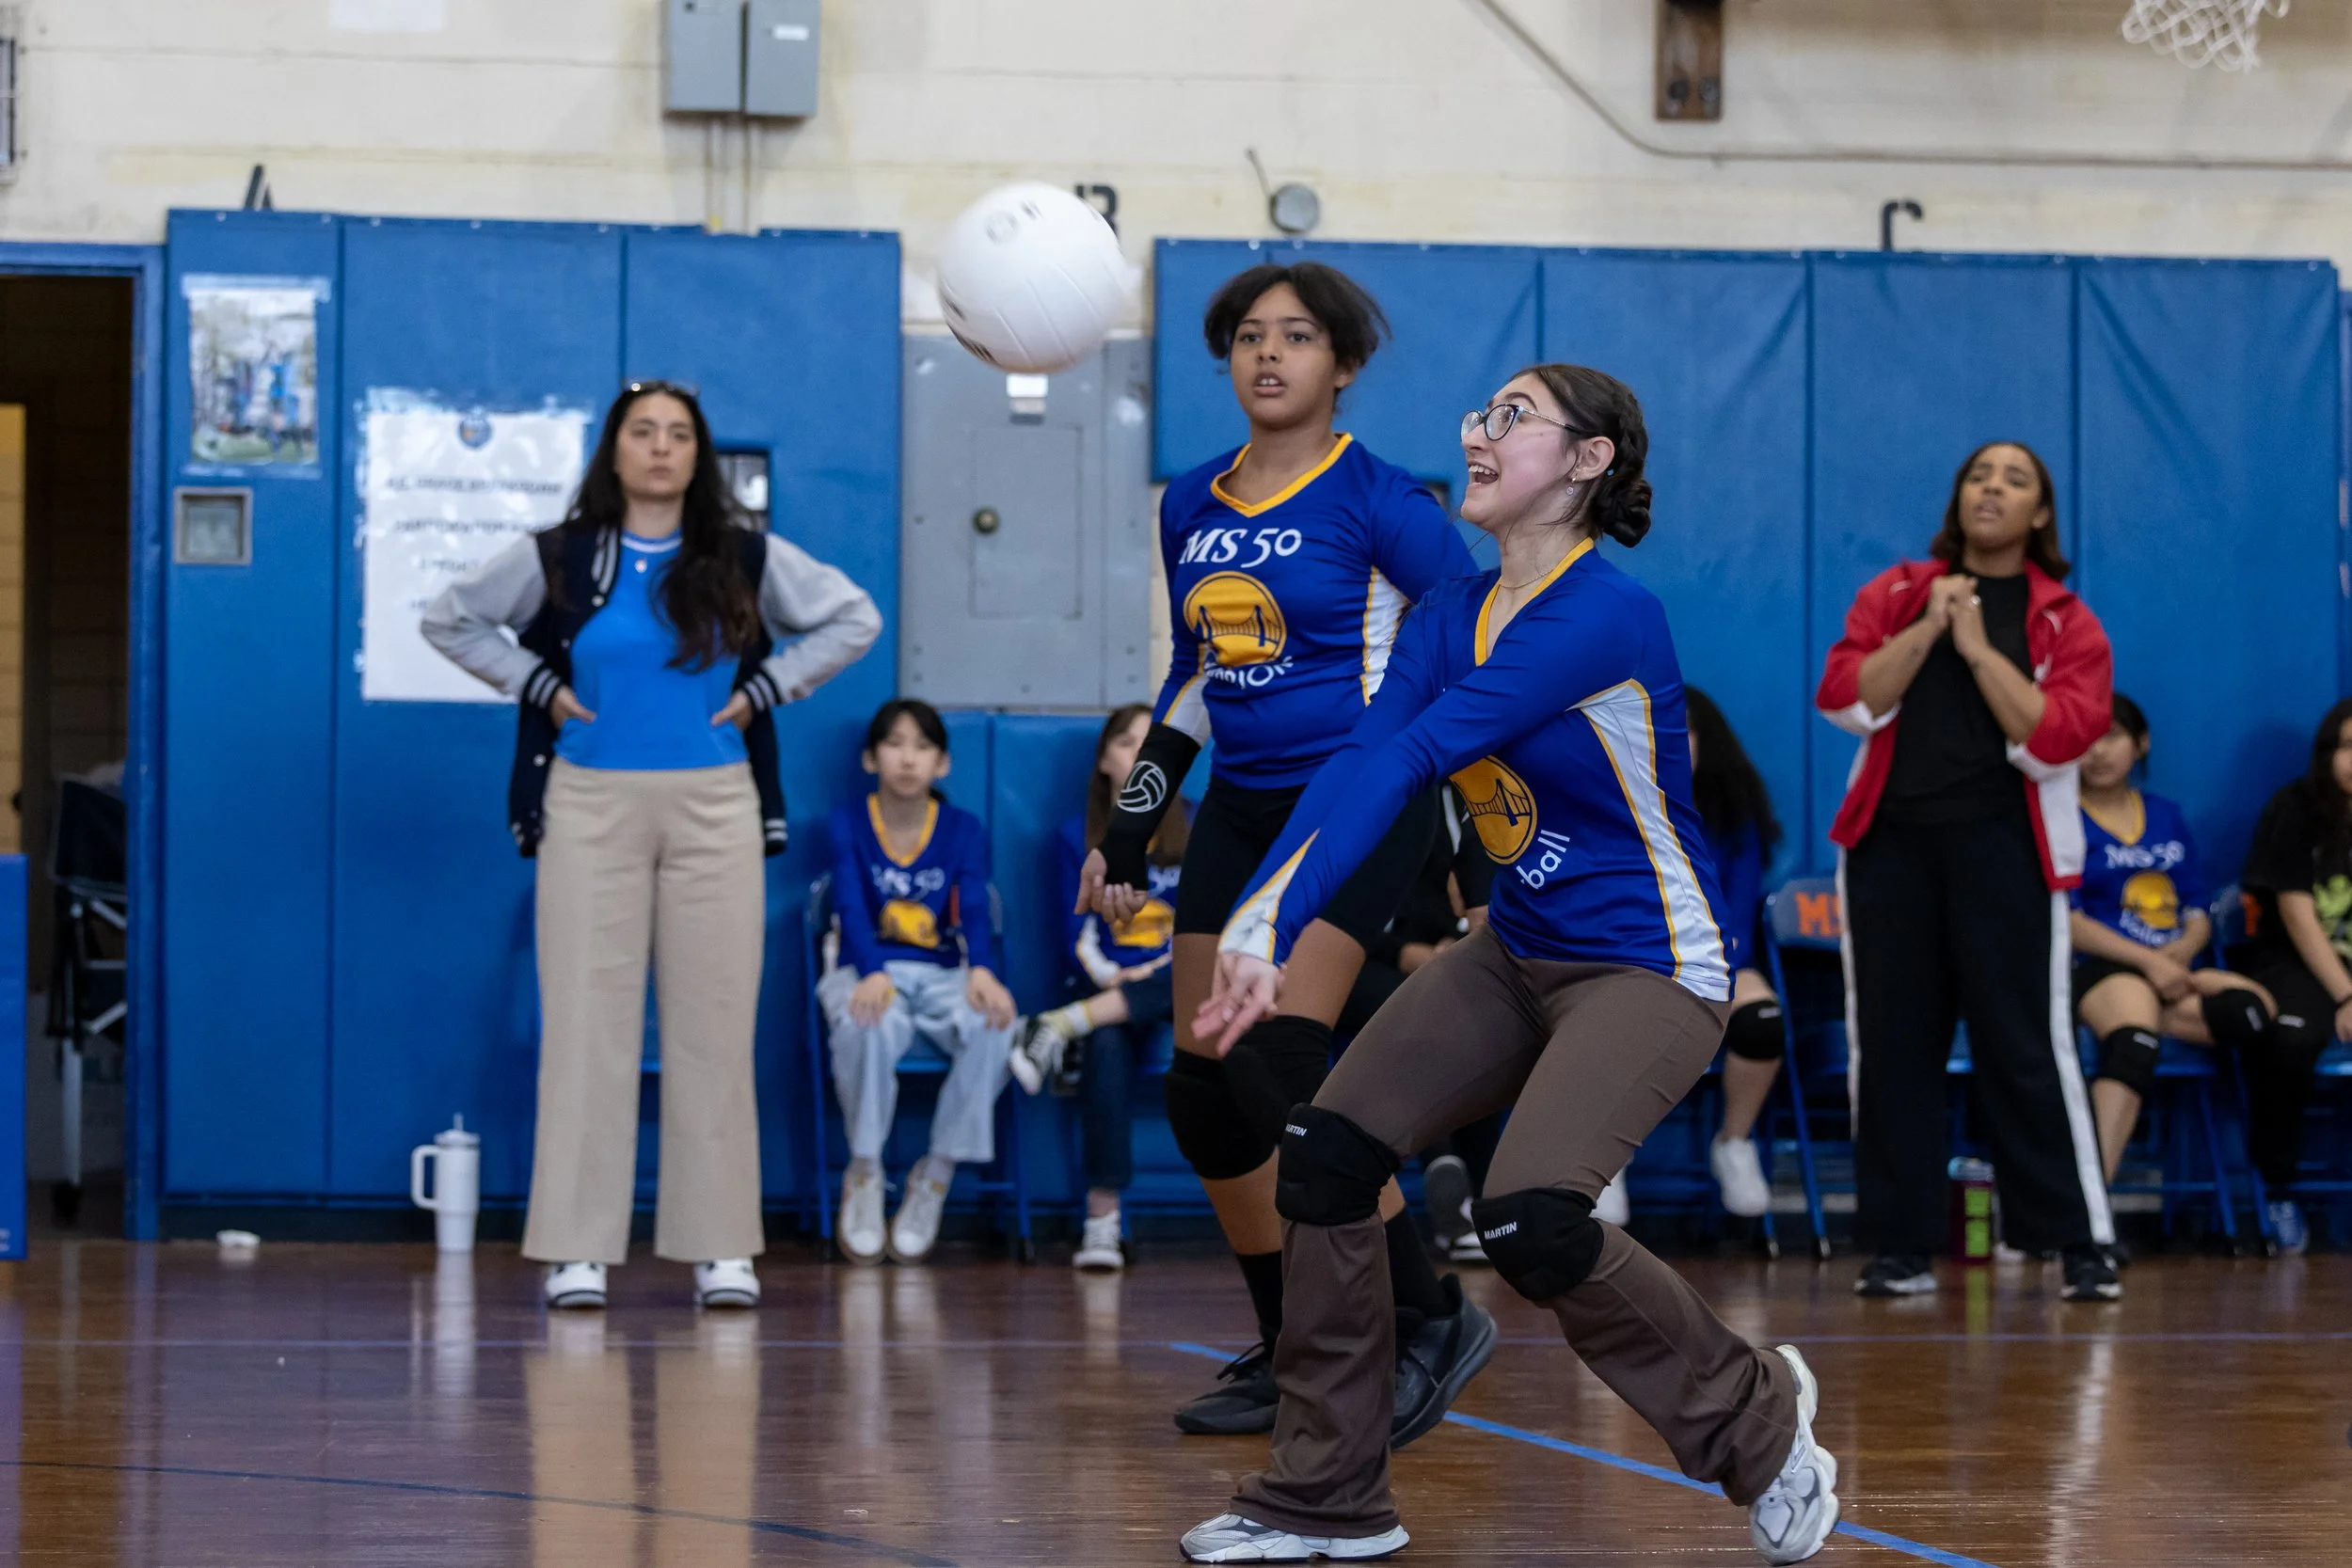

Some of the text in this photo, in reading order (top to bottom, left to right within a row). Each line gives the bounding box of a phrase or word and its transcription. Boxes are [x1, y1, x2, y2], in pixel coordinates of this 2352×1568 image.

[1178, 528, 1303, 569] MS 50
[1516, 829, 1571, 890] ball
[1484, 1221, 1518, 1241] MARTIN
